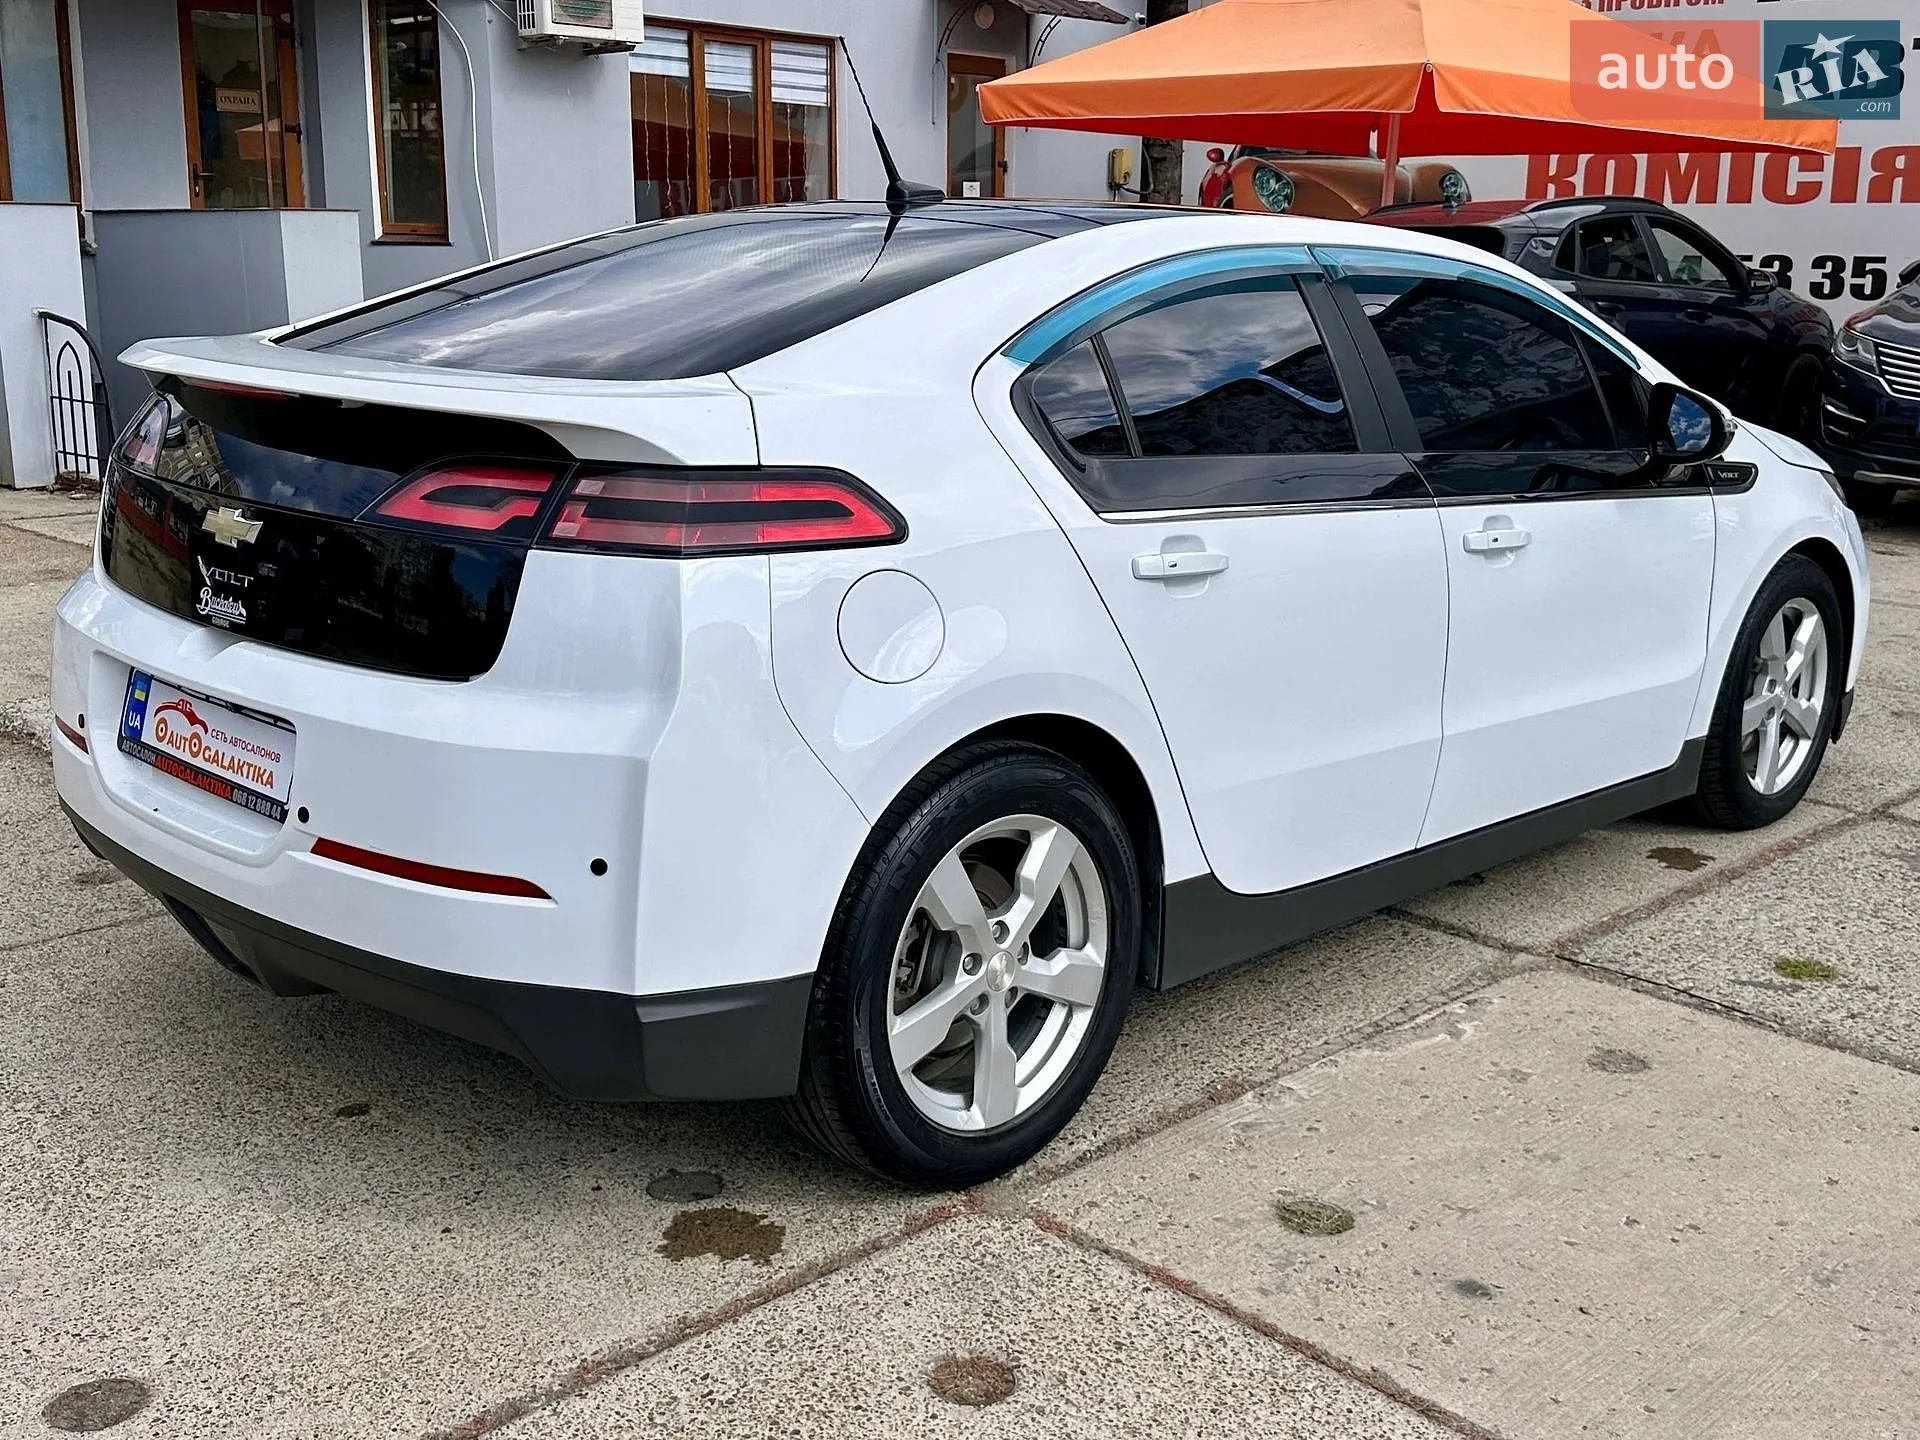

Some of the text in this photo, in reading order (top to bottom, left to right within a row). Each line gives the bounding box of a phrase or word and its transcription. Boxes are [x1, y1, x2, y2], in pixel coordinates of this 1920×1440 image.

[1597, 0, 1725, 12] ПРОБІ
[220, 95, 257, 106] ОХРАНА
[1525, 146, 1920, 205] КОМІСІЯ
[1809, 254, 1887, 301] 35
[197, 554, 255, 588] VOLT
[127, 710, 141, 731] UA
[210, 728, 282, 764] СЕТЬ АВТОСАЛОНОВ
[155, 754, 232, 801] AUTOGALAKTIKA
